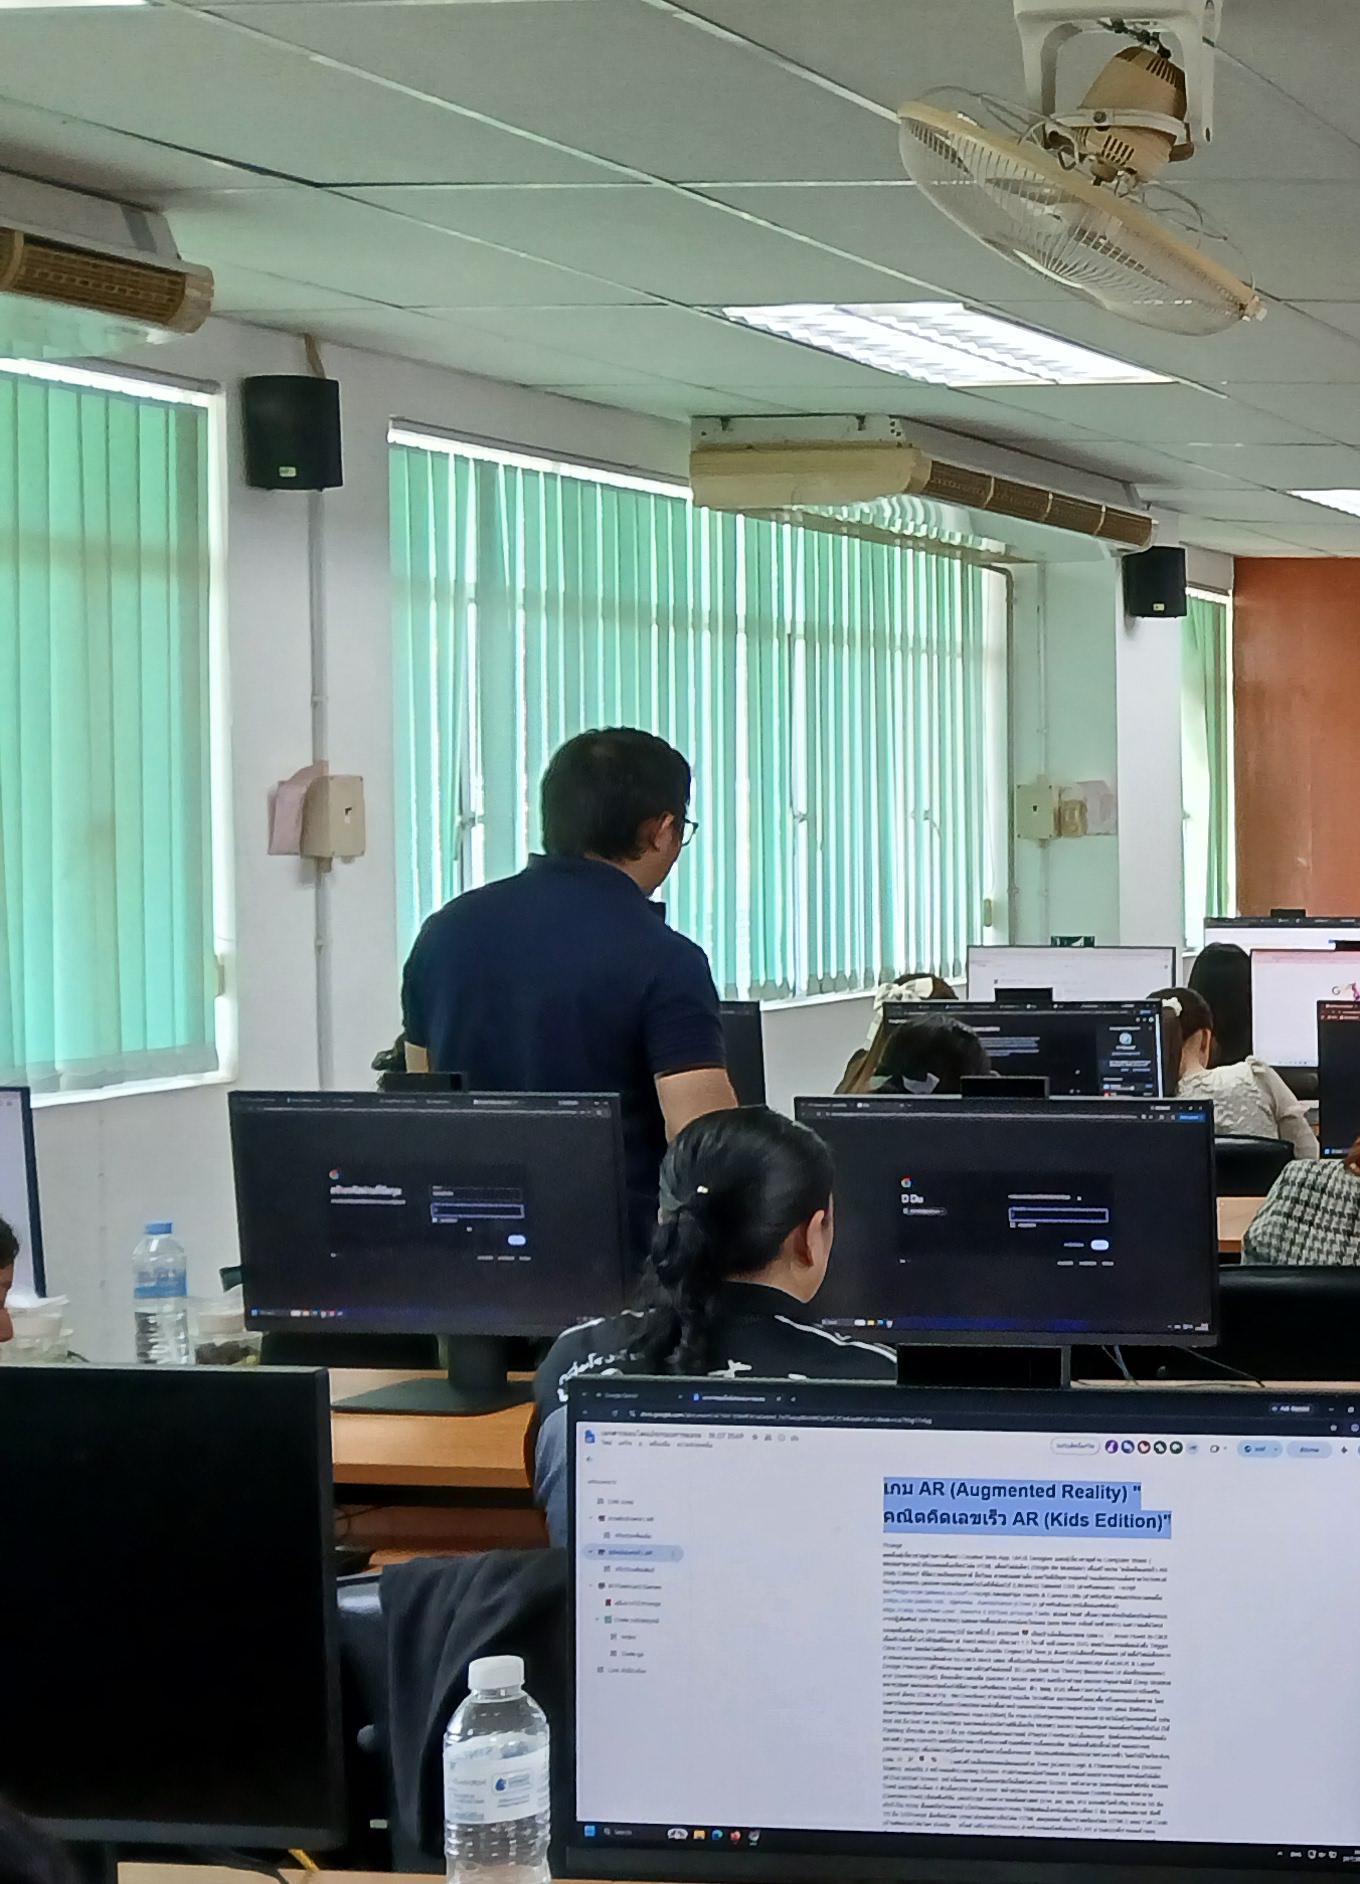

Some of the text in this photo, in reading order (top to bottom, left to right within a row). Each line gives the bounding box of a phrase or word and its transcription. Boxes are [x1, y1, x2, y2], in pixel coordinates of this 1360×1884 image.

[919, 1481, 945, 1497] AR
[950, 1483, 1056, 1502] (Augmented
[1062, 1483, 1128, 1504] Reality)
[1012, 1511, 1040, 1528] AR
[1044, 1512, 1090, 1531] (Kids
